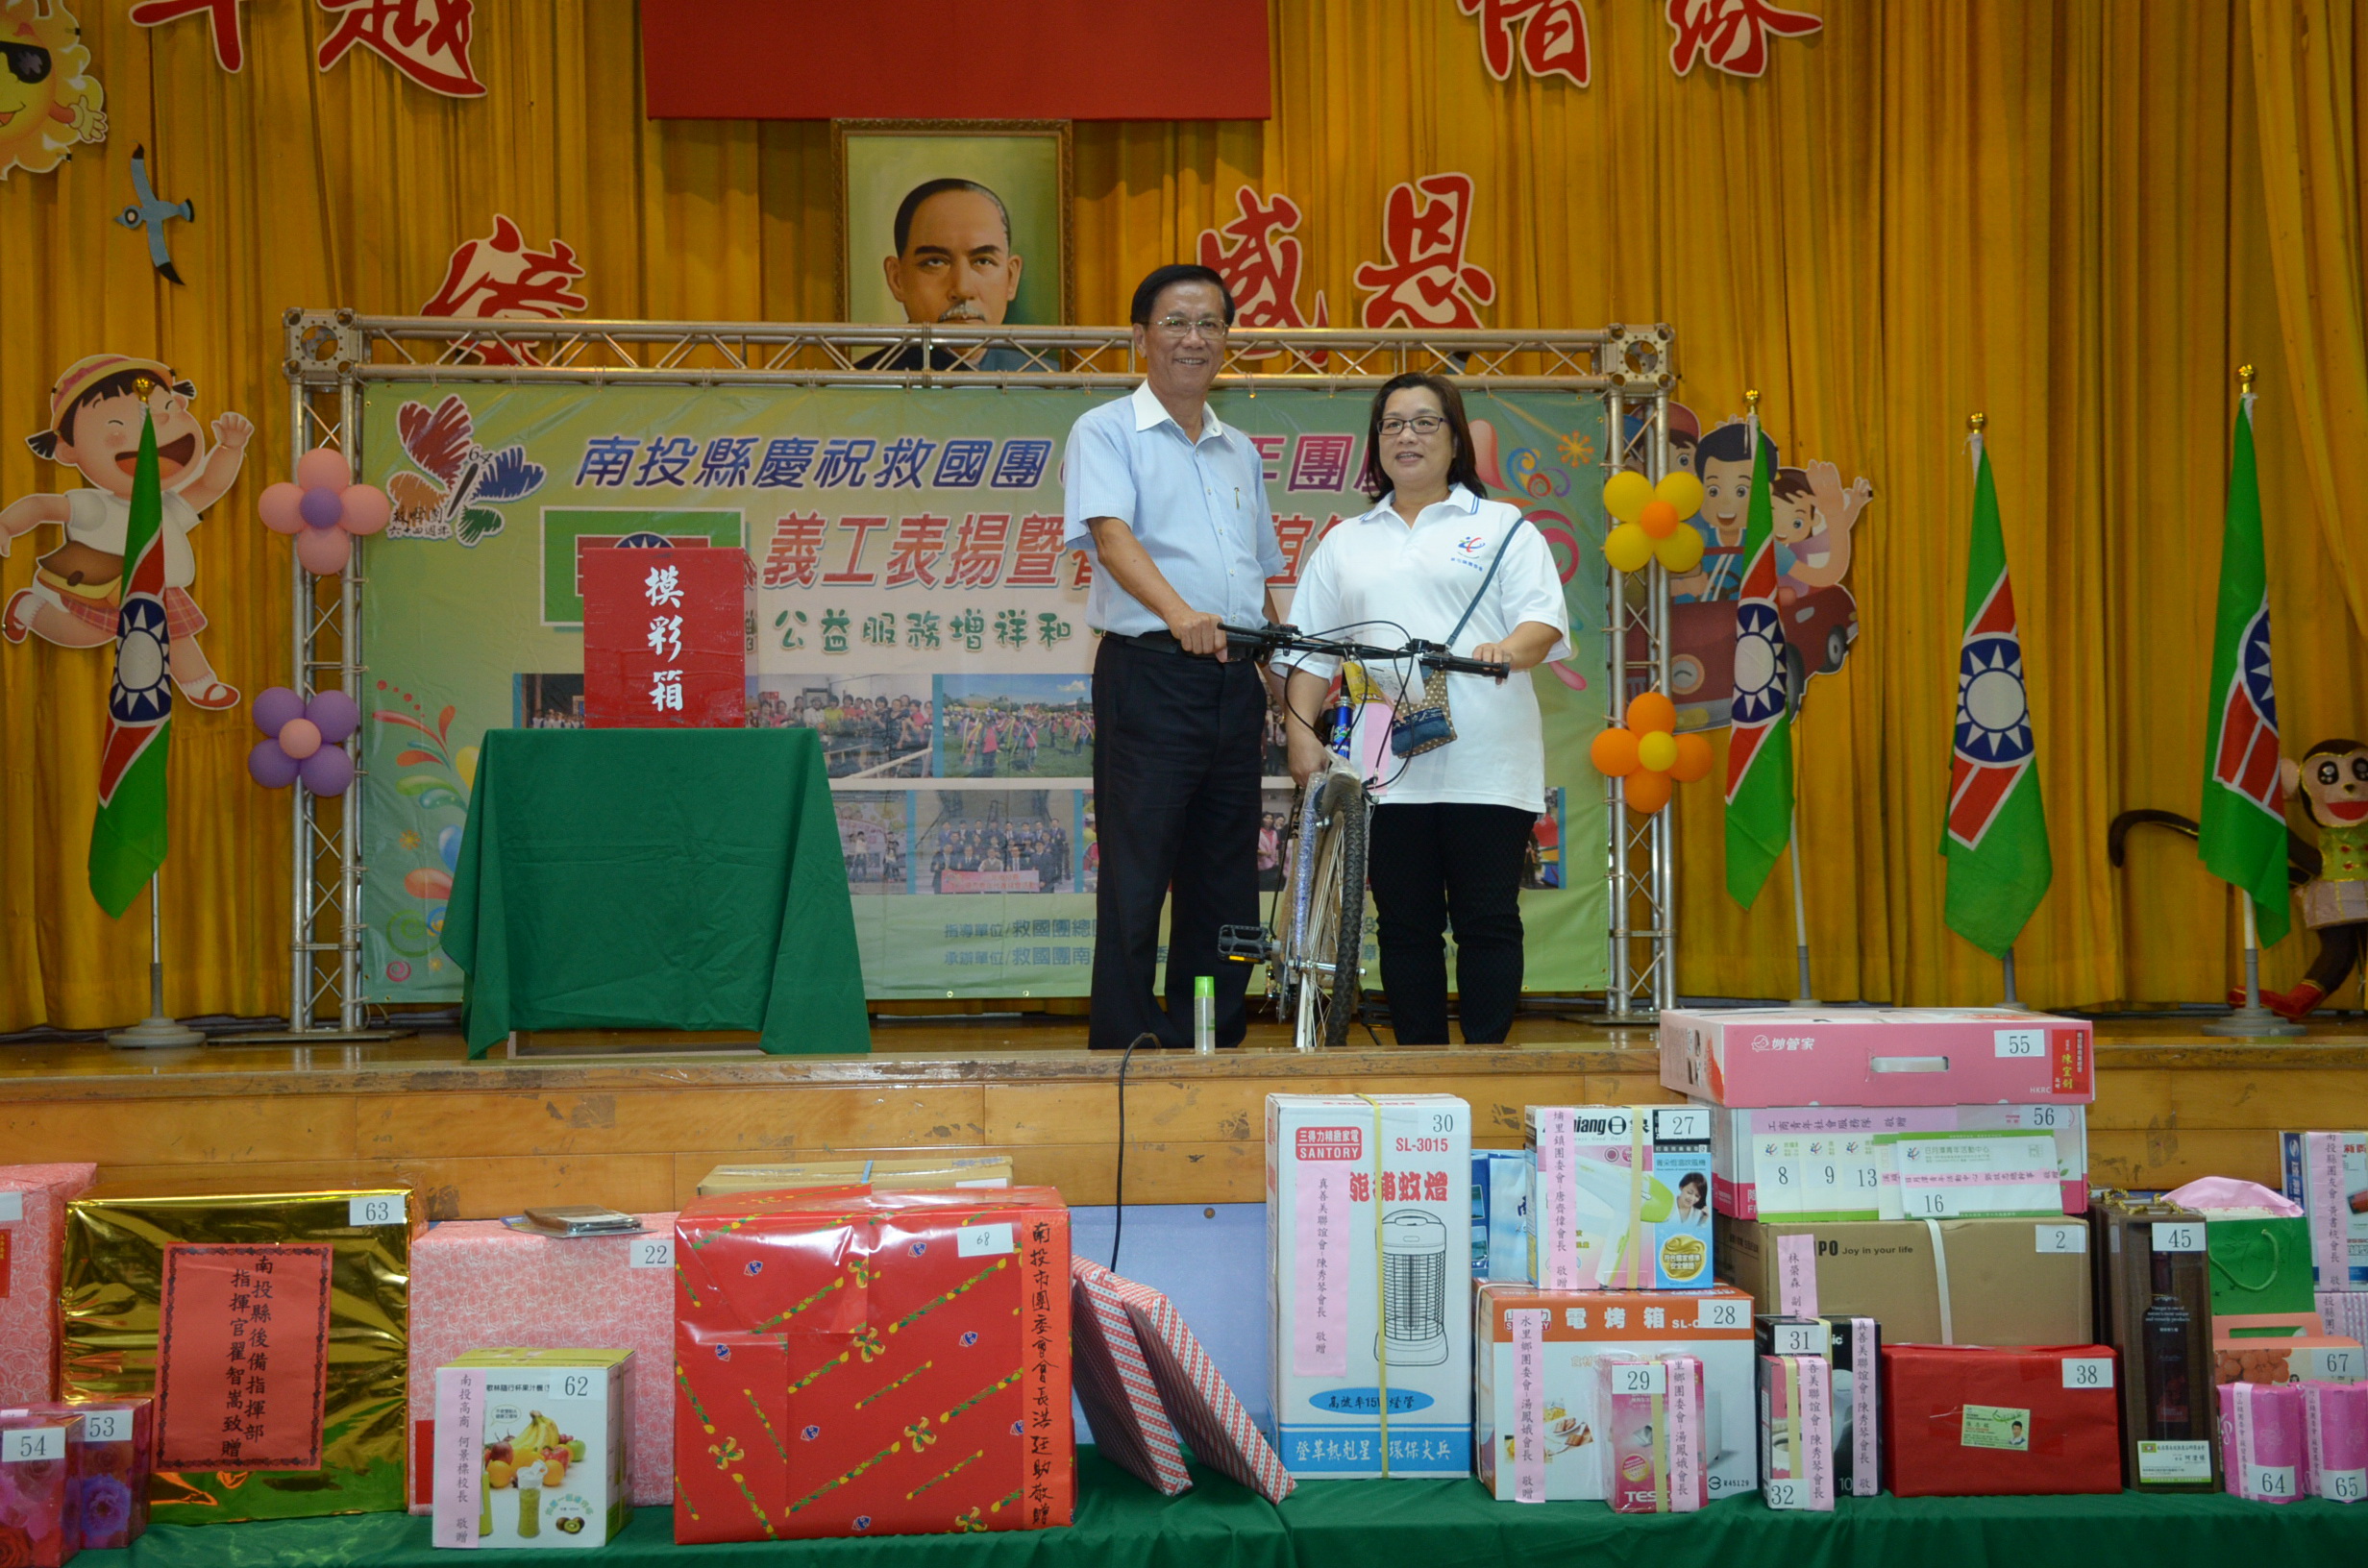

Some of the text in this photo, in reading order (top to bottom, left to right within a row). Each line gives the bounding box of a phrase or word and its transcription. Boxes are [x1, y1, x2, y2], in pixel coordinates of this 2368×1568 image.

[574, 436, 1054, 488] 南投縣慶祝救國團
[644, 565, 684, 713] 摸彩箱
[775, 608, 1071, 652] 公益服務增祥和
[944, 919, 1097, 939] 指導單位/救國團總
[1772, 1037, 1815, 1051] 妙管家
[2010, 1036, 2030, 1054] 55
[1433, 1115, 1454, 1133] 30
[1672, 1116, 1694, 1135] 27
[2034, 1107, 2055, 1125] 56
[1300, 1147, 1360, 1160] SANTORY
[1395, 1138, 1448, 1152] SL-3015
[1778, 1166, 1788, 1185] 8
[1825, 1166, 1835, 1185] 9
[1858, 1168, 1877, 1188] 13
[365, 1202, 389, 1222] 63
[1925, 1194, 1944, 1213] 16
[976, 1233, 991, 1246] 68
[2056, 1231, 2066, 1248] 2
[2168, 1229, 2192, 1248] 45
[645, 1245, 668, 1265] 22
[1842, 1247, 1861, 1256] Joy
[1875, 1247, 1896, 1256] your
[1556, 1265, 1568, 1288] 敬贈
[1566, 1307, 1665, 1330] 電烤箱
[1714, 1306, 1736, 1326] 28
[242, 1255, 273, 1444] 南投縣後備指揮部
[1316, 1331, 1327, 1355] 敬贈
[1789, 1331, 1811, 1350] 31
[2327, 1354, 2349, 1373] 67
[1628, 1371, 1650, 1391] 29
[2077, 1365, 2098, 1384] 38
[565, 1376, 588, 1397] 62
[458, 1374, 473, 1429] 南投高商
[88, 1416, 115, 1437] 53
[20, 1435, 47, 1458] 54
[1520, 1475, 1534, 1500] 敬贈
[2261, 1473, 2285, 1494] 64
[2335, 1477, 2358, 1497] 65
[1771, 1485, 1794, 1506] 32
[456, 1517, 469, 1543] 敬贈
